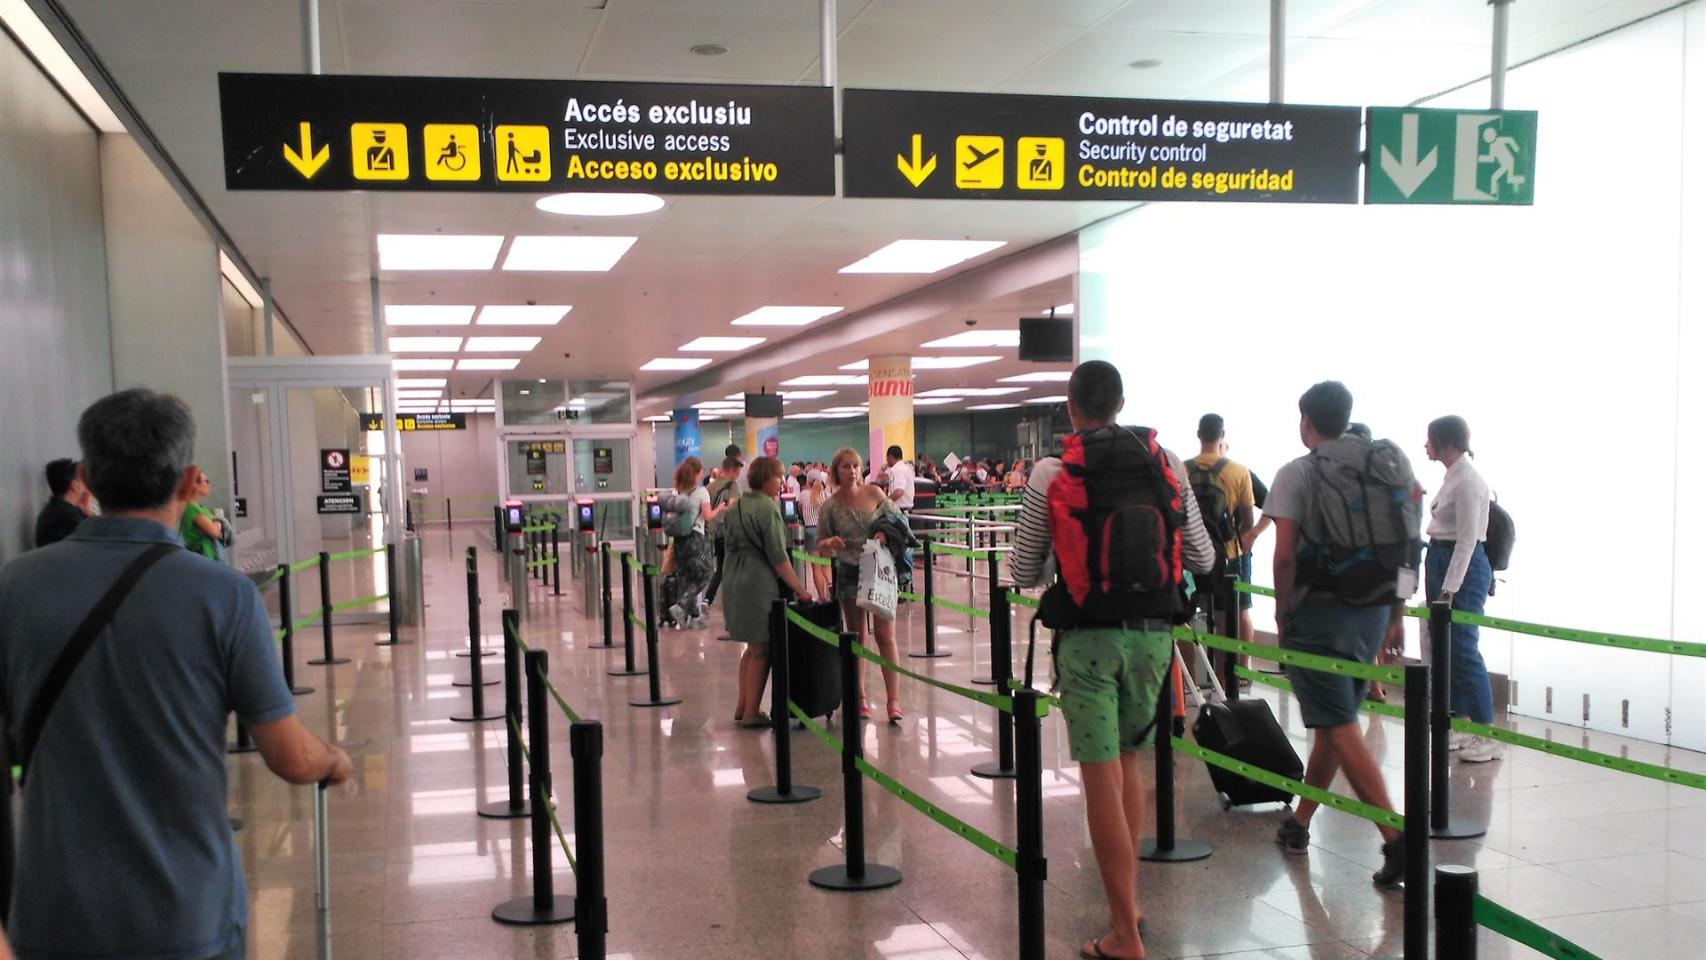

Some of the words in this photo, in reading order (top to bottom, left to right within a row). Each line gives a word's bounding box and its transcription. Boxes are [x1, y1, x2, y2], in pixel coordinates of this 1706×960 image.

[564, 97, 641, 123] Accés
[648, 100, 751, 125] exclusiu
[564, 128, 655, 150] Exclusive
[664, 134, 731, 152] access
[1078, 111, 1158, 136] Control
[1162, 115, 1188, 137] de
[1192, 120, 1293, 143] seguretat
[1078, 139, 1147, 164] Security
[1150, 143, 1207, 162] control
[566, 154, 658, 180] Acceso
[664, 156, 778, 182] exclusivo
[1078, 163, 1157, 188] Control
[1161, 166, 1188, 189] de
[1191, 168, 1294, 194] seguridad
